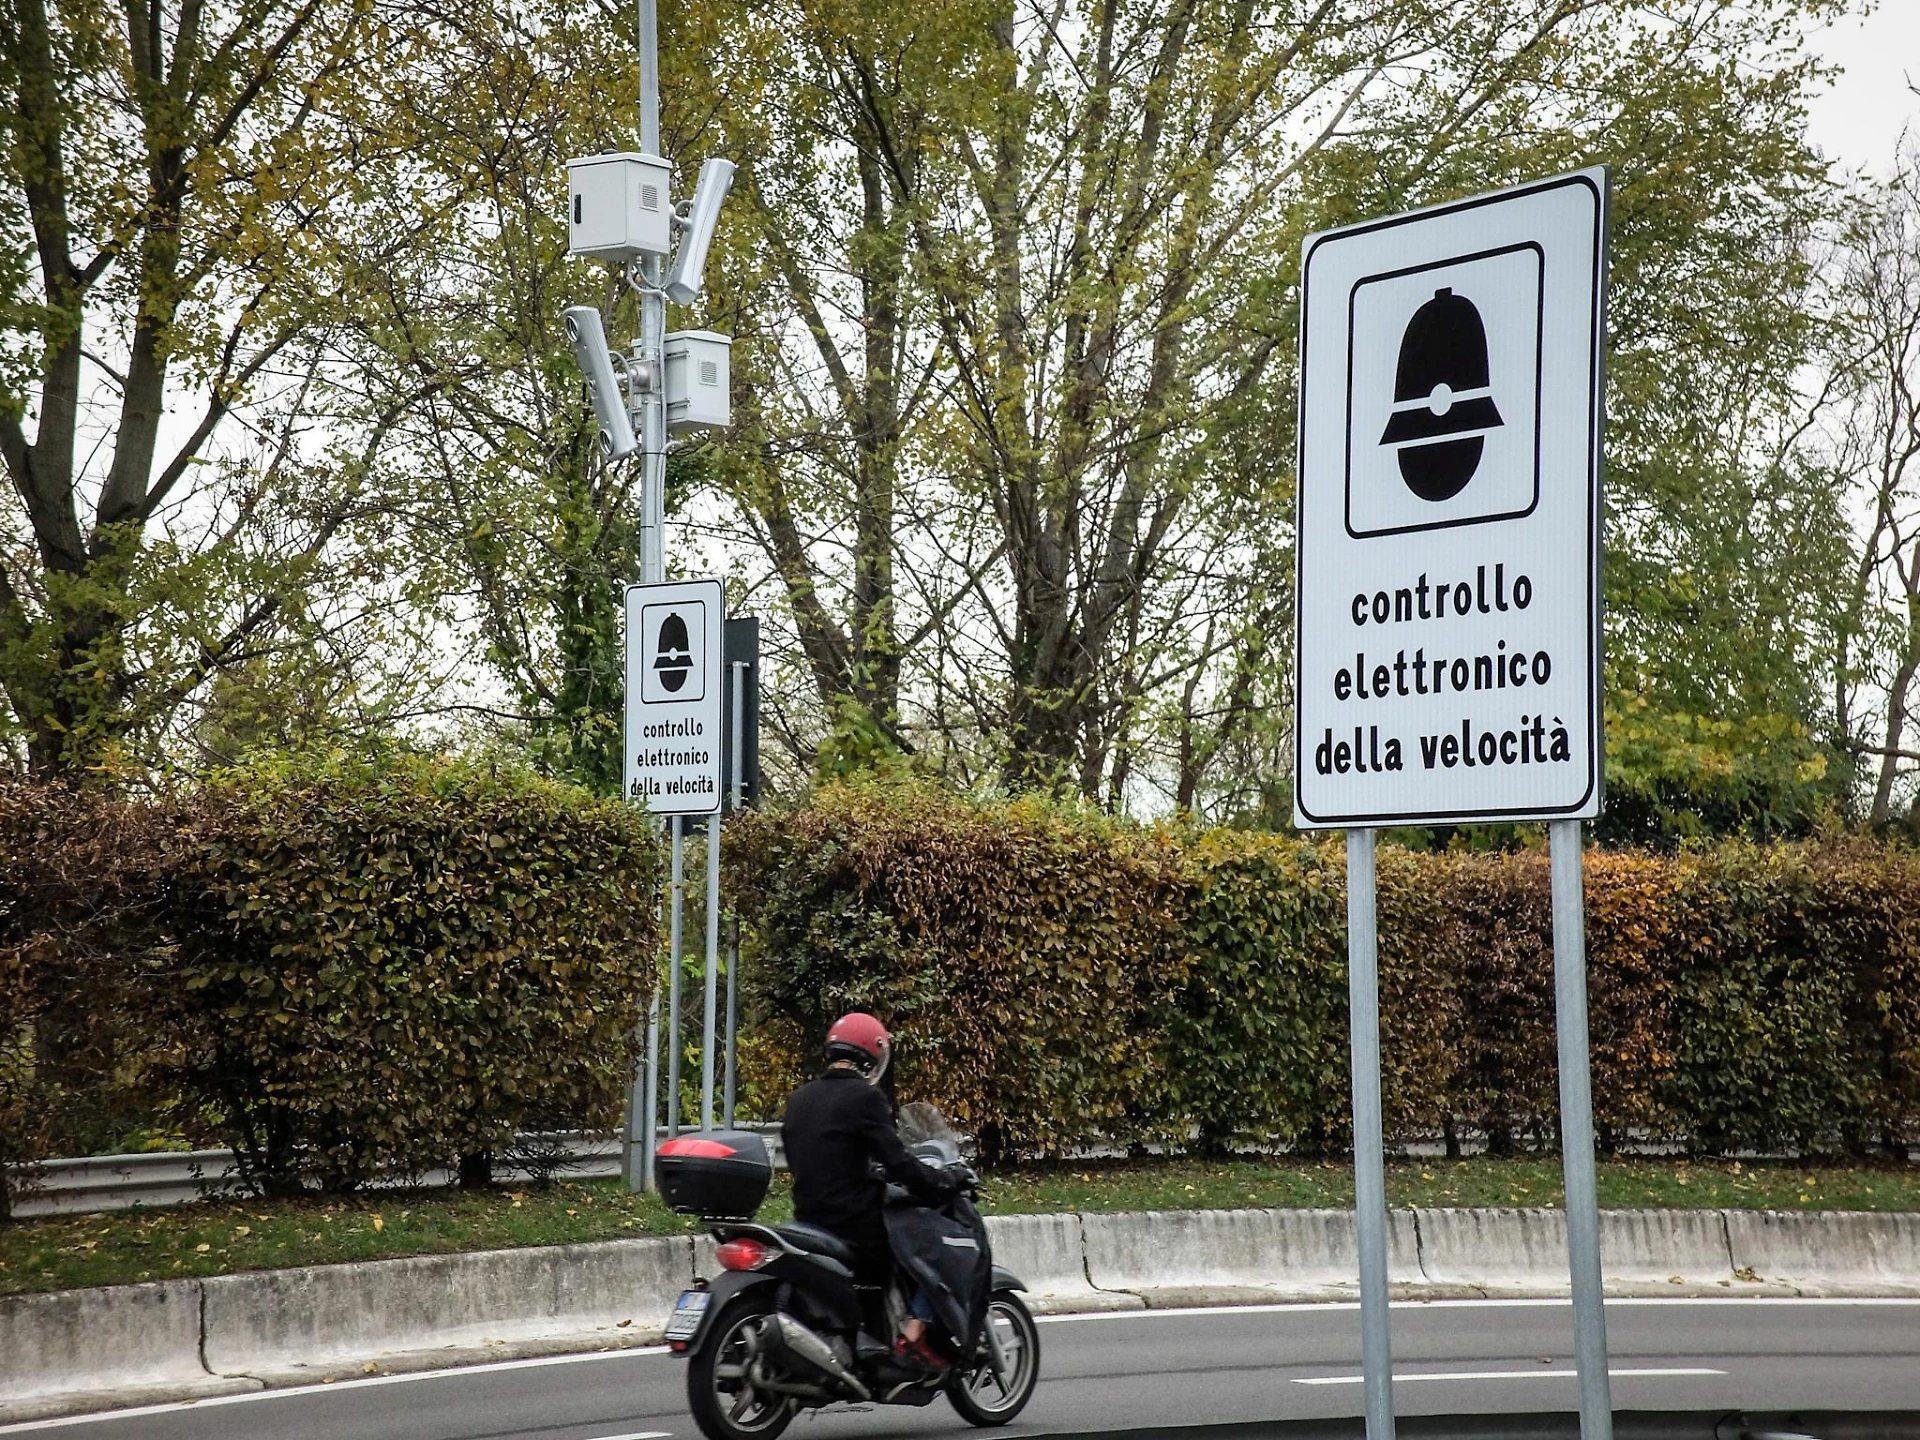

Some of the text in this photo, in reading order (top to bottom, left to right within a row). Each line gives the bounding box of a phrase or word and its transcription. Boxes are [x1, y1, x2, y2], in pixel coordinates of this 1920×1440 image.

[1352, 563, 1533, 627] controllo
[1335, 639, 1552, 701] elettronico
[643, 717, 704, 738] controllo
[1315, 714, 1572, 776] della velocità
[637, 746, 709, 767] elettronico
[630, 775, 714, 796] della velocità
